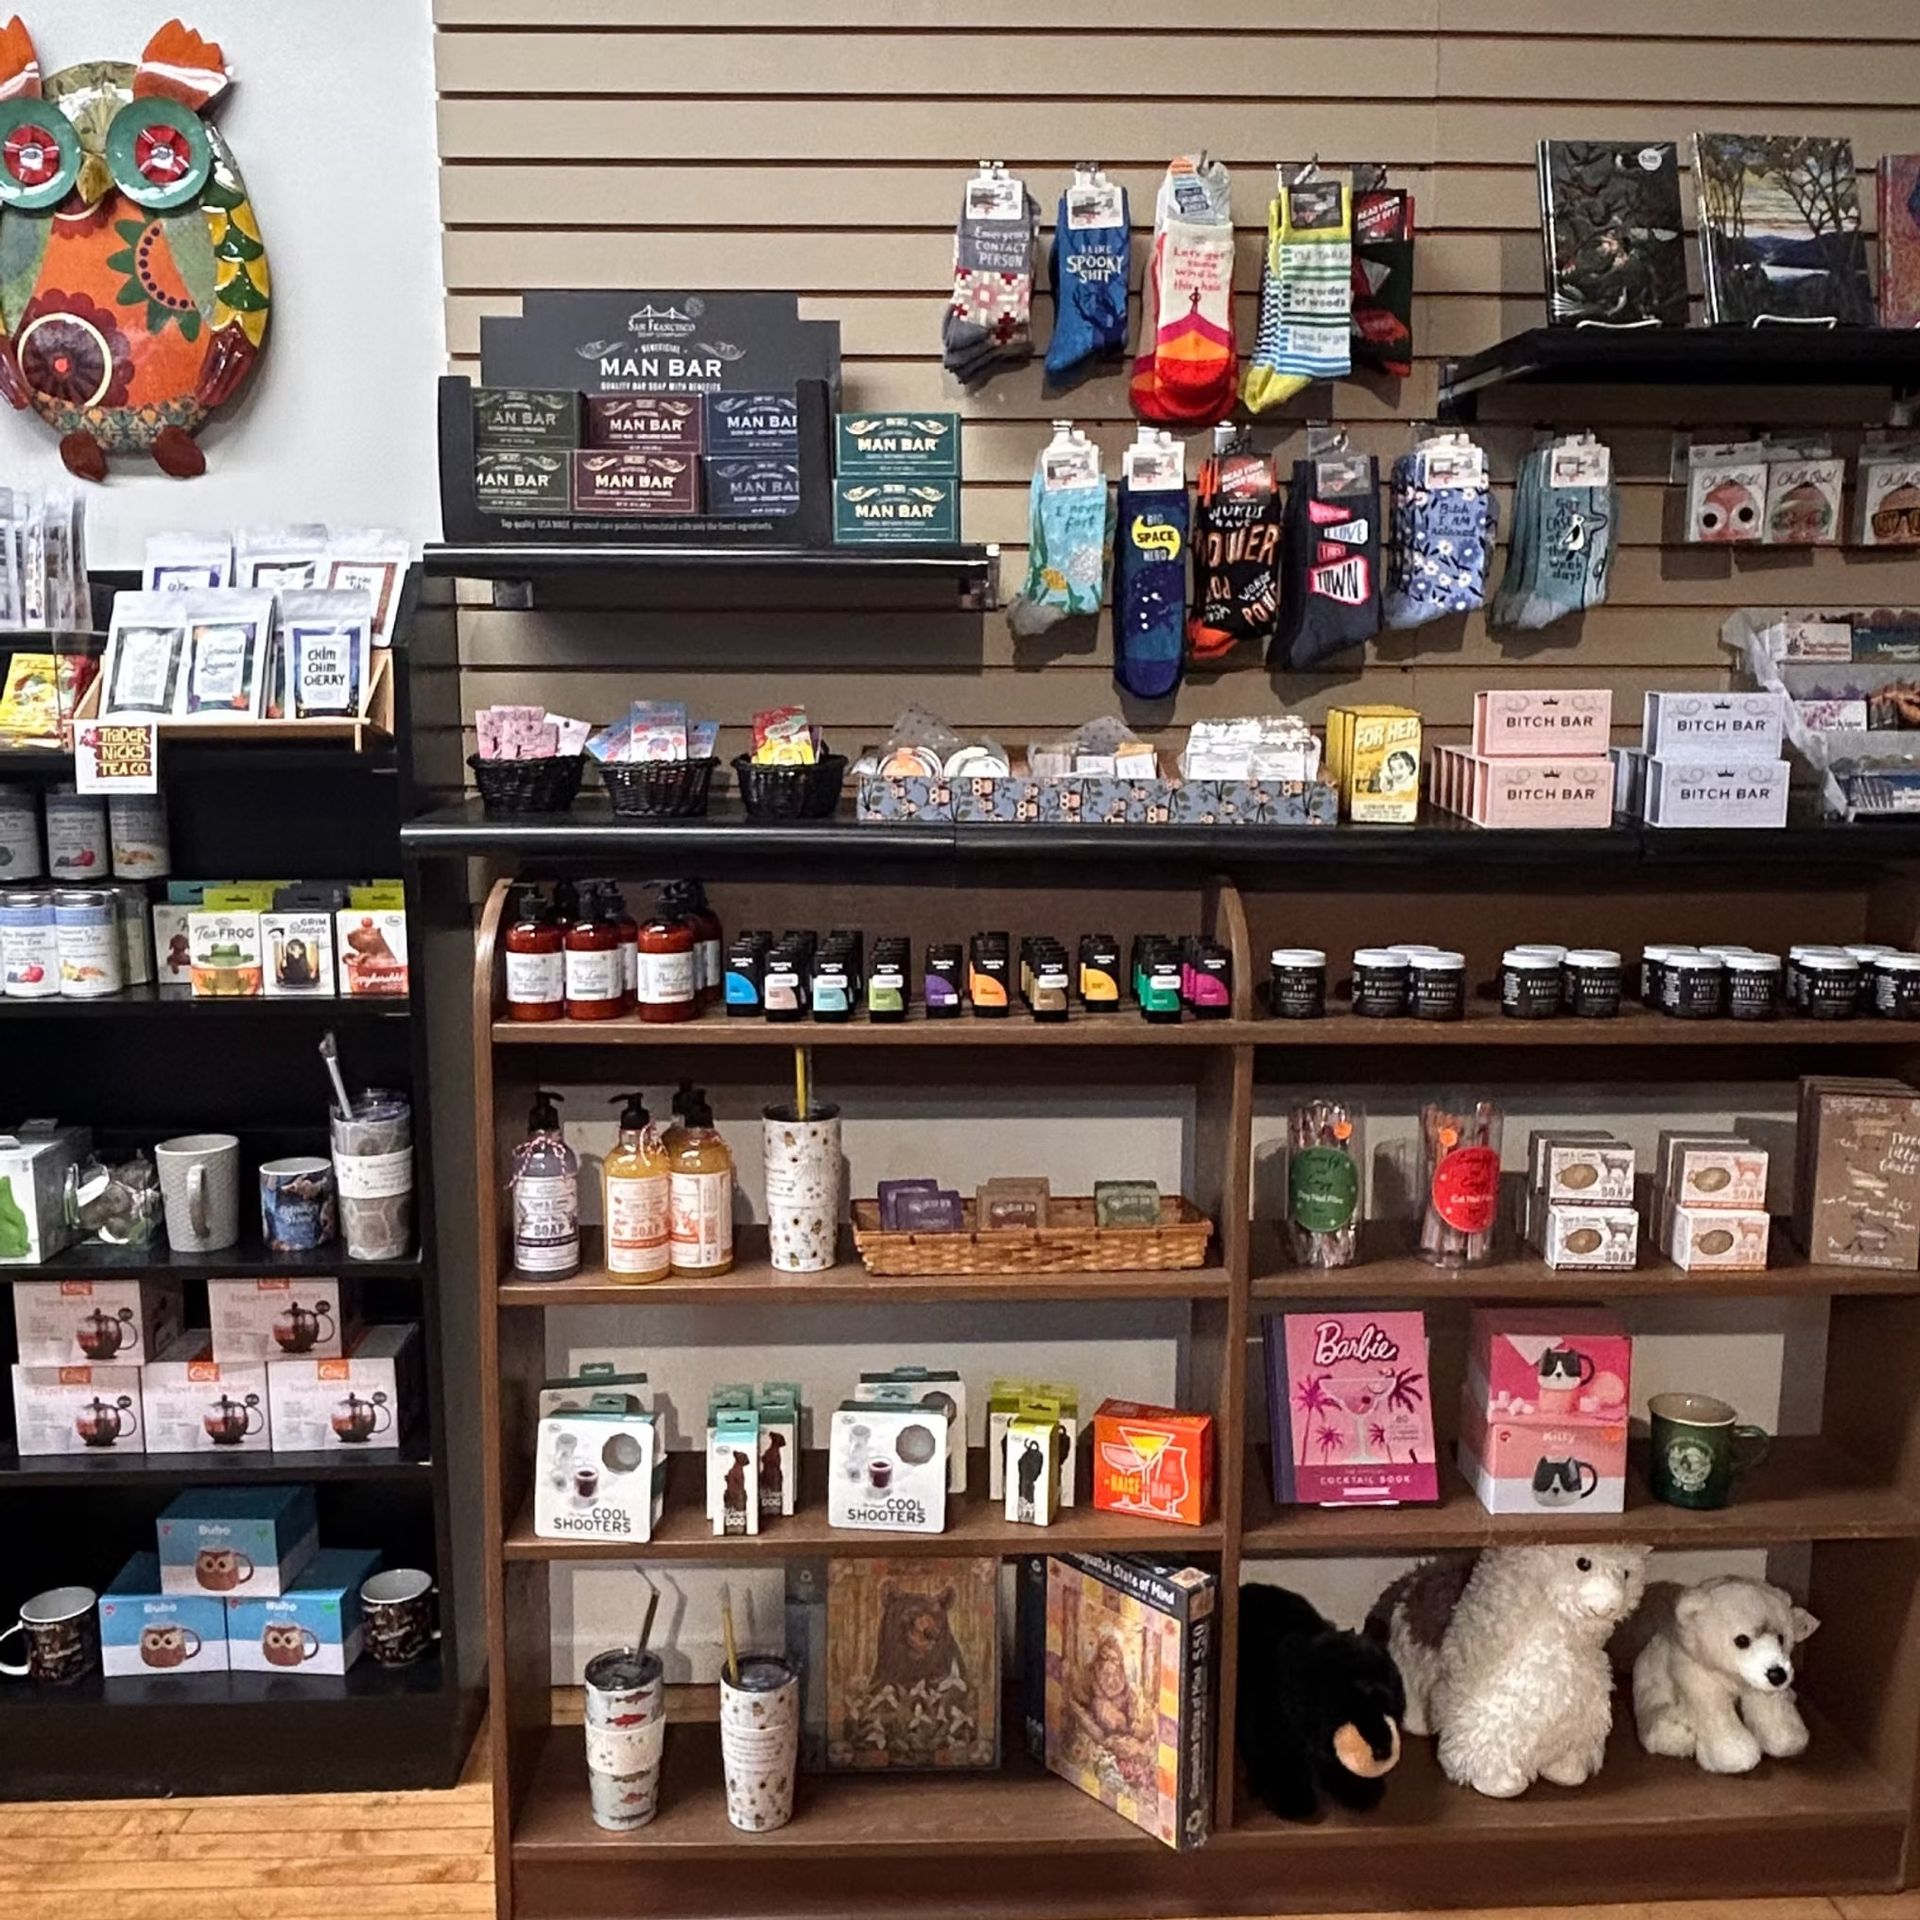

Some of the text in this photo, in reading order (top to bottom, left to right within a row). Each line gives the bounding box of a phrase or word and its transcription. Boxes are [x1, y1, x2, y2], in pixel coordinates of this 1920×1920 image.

[975, 240, 1028, 253] CONTACT
[979, 252, 1024, 267] PERSON
[1065, 255, 1125, 275] SPOOKY
[1079, 269, 1113, 284] SHIT
[600, 358, 723, 377] MAN BAR
[632, 382, 647, 391] BAR
[522, 413, 556, 425] BAR
[608, 419, 683, 431] MAN BAR
[727, 416, 764, 428] MAN
[857, 438, 937, 451] MAN BAR
[514, 475, 549, 487] BAR
[595, 474, 674, 488] MAN BAR
[730, 482, 767, 494] MAN
[855, 505, 934, 518] MAN BAR
[1137, 531, 1176, 543] SPACE
[1333, 522, 1363, 542] LOVE
[1316, 560, 1359, 599] TOWN
[304, 674, 346, 686] CHERRY
[1506, 716, 1593, 728] BITCH BAR
[1677, 720, 1766, 732] BITCH BAR
[1357, 719, 1418, 752] FOR HER
[99, 762, 128, 776] TEA
[1507, 788, 1596, 801] BITCH BAR
[1681, 788, 1770, 800] BITCH BAR
[289, 921, 327, 936] Sleeper
[301, 918, 327, 927] GRIM
[195, 926, 255, 940] Tea FROG
[1601, 1186, 1632, 1198] SOAP
[534, 1223, 565, 1236] SOAP
[631, 1224, 660, 1237] SOAP
[1605, 1250, 1634, 1262] SOAP
[1315, 1320, 1398, 1365] Barbie
[1543, 1430, 1576, 1444] Kitty
[1110, 1475, 1141, 1496] RAISE
[1320, 1474, 1412, 1486] COCKTAIL BOOK
[761, 1498, 781, 1507] DOG
[886, 1498, 925, 1512] COOL
[592, 1507, 631, 1522] COOL
[848, 1508, 926, 1524] SHOOTERS
[553, 1517, 632, 1534] SHOOTERS
[1139, 1579, 1150, 1591] of
[1151, 1582, 1175, 1605] Mind
[1192, 1624, 1205, 1661] 550
